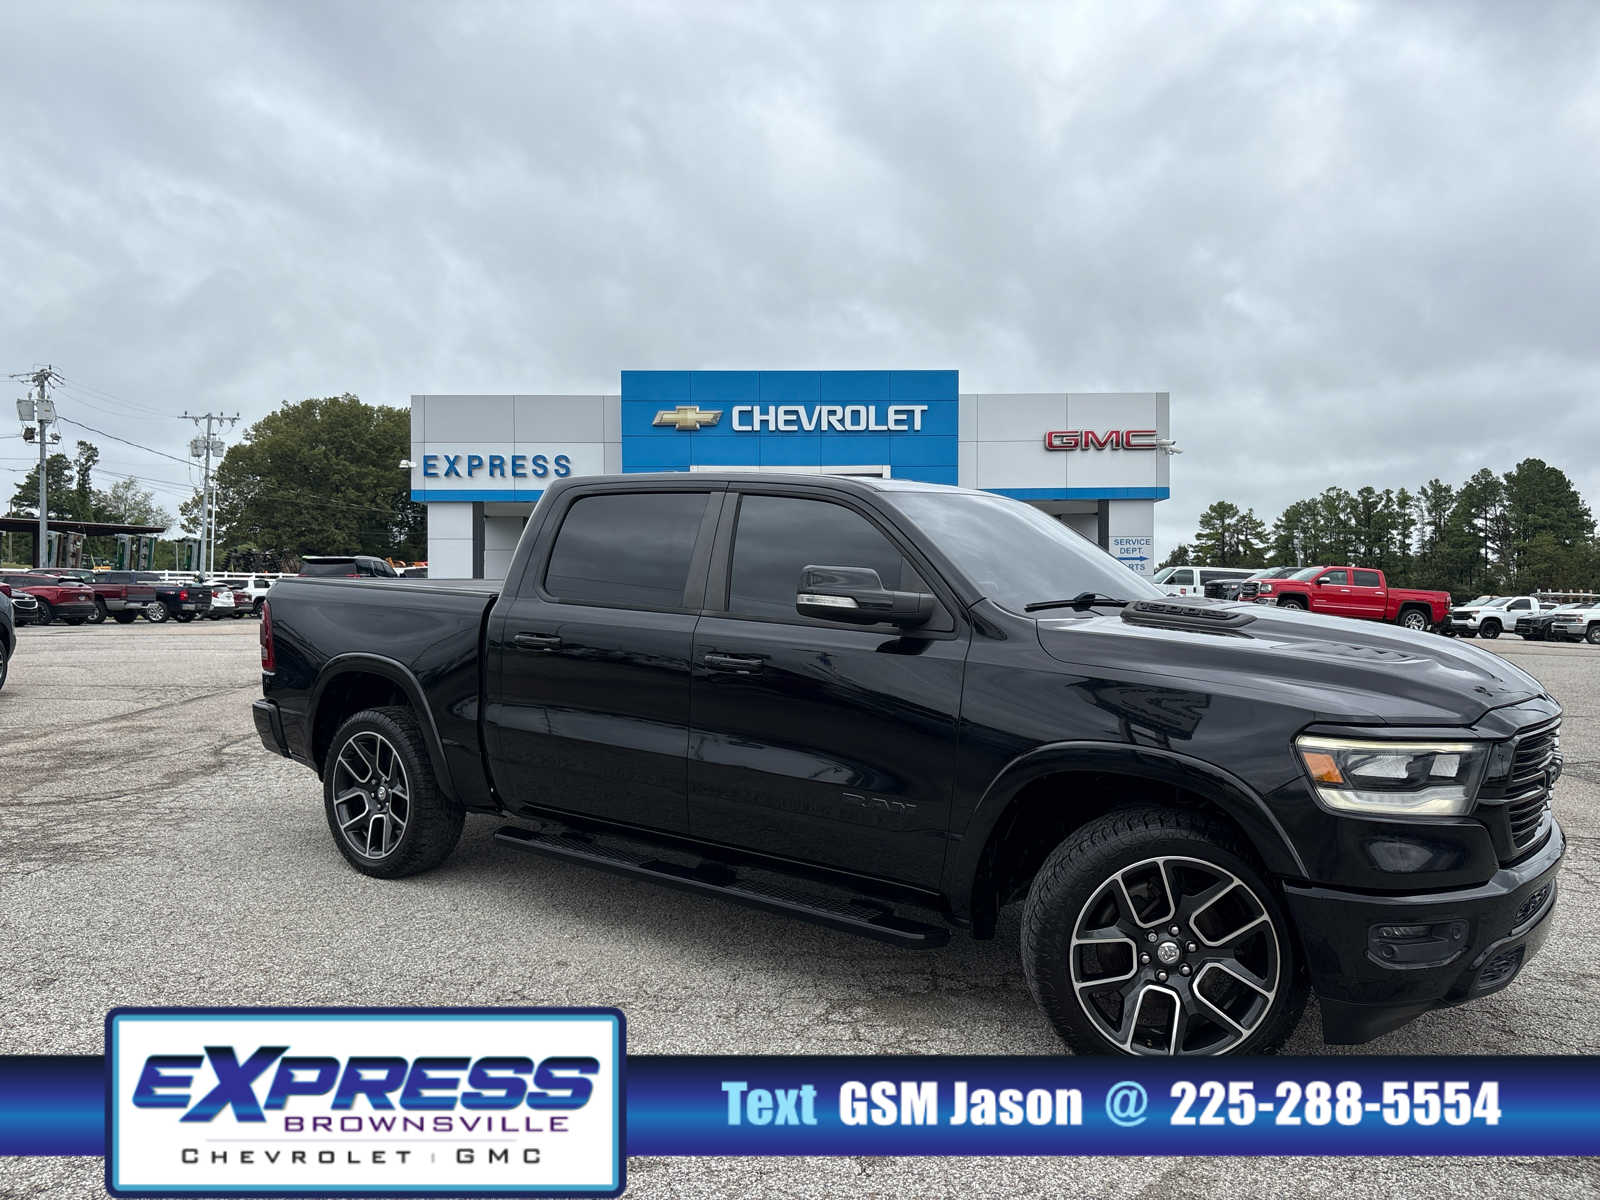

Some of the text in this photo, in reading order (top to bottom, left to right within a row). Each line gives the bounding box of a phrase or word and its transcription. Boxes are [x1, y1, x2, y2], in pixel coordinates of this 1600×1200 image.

[731, 404, 928, 432] CHEVROLET
[1046, 429, 1157, 450] GMC
[423, 454, 571, 478] EXPRESS
[1113, 538, 1151, 546] SERVICE
[1119, 547, 1144, 555] DEPT.
[1128, 563, 1145, 571] RTS
